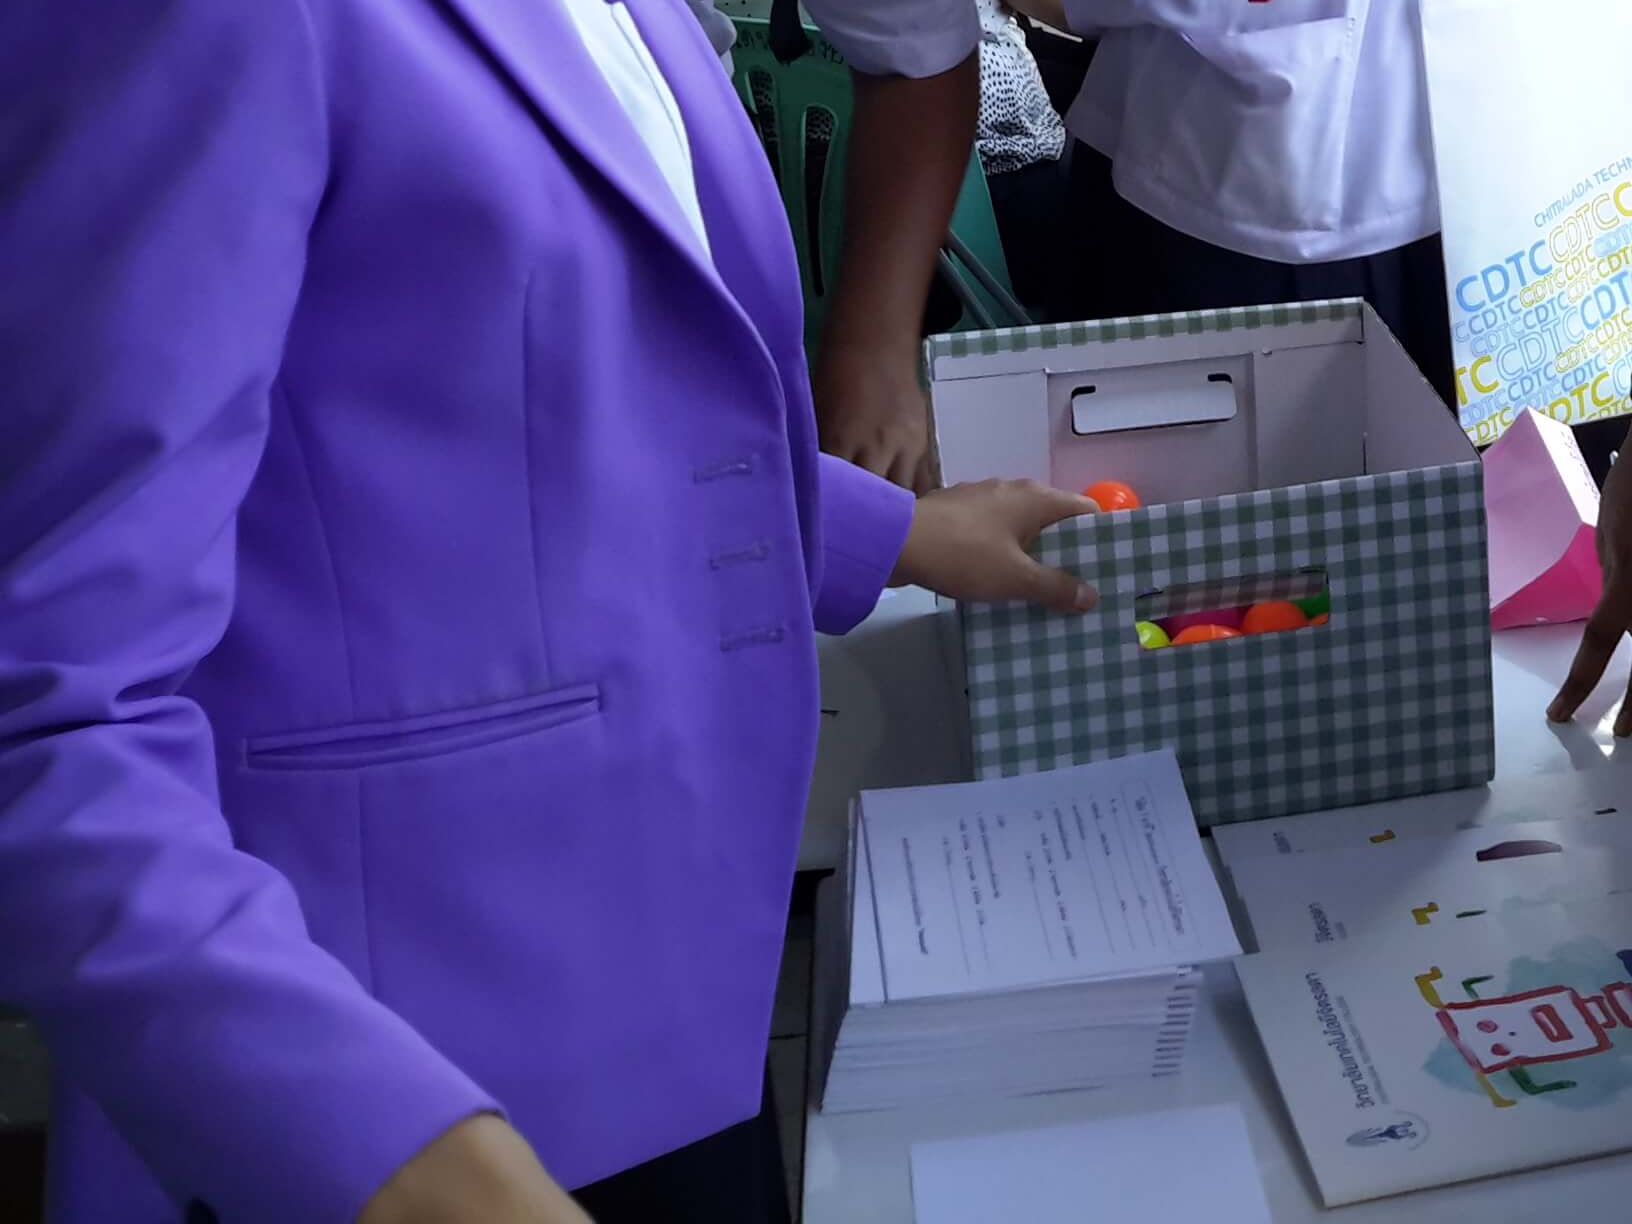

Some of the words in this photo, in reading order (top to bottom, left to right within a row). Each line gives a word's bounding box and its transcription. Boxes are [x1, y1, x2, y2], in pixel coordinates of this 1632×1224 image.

[1534, 177, 1594, 228] CHITRALADA
[1456, 239, 1553, 313] CDTC
[1549, 192, 1620, 264] CDTC
[1468, 295, 1522, 336] CDTC
[1520, 267, 1566, 308] CDTC
[1565, 244, 1597, 281] CDTC
[1523, 291, 1569, 330] CDTC
[1497, 306, 1584, 381] CDTC
[1508, 361, 1557, 401] CDTC
[1562, 354, 1608, 392] CDTC
